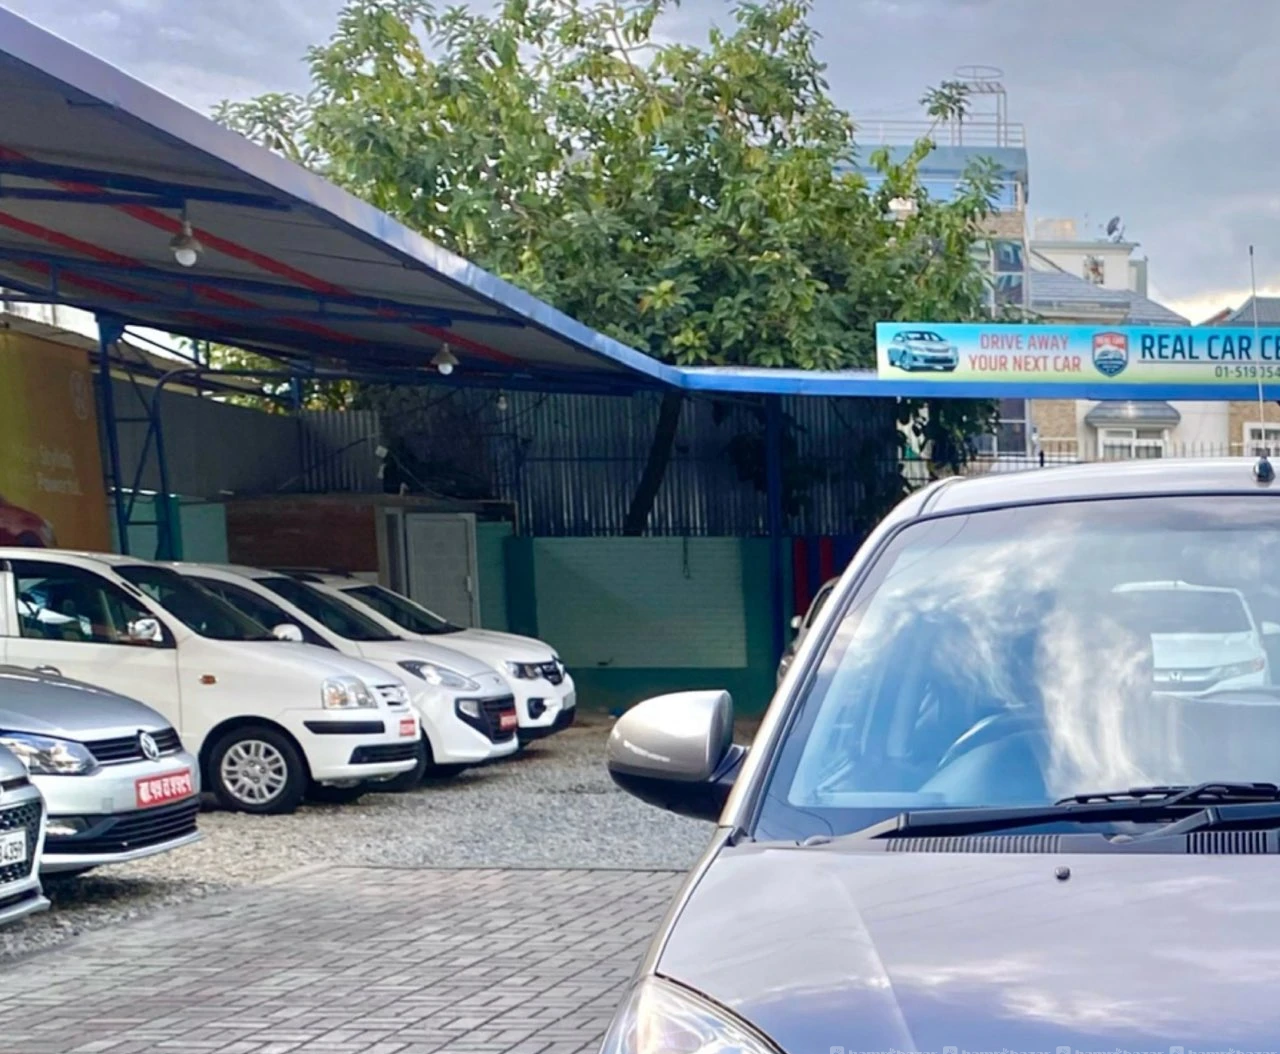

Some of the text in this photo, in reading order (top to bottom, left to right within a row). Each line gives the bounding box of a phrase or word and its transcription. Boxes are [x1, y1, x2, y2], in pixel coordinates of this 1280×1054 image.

[980, 334, 1069, 350] DRIVE AWAY
[1141, 334, 1200, 360] REAL
[1207, 334, 1252, 361] CAR
[968, 354, 1082, 372] YOUR NEXT CAR
